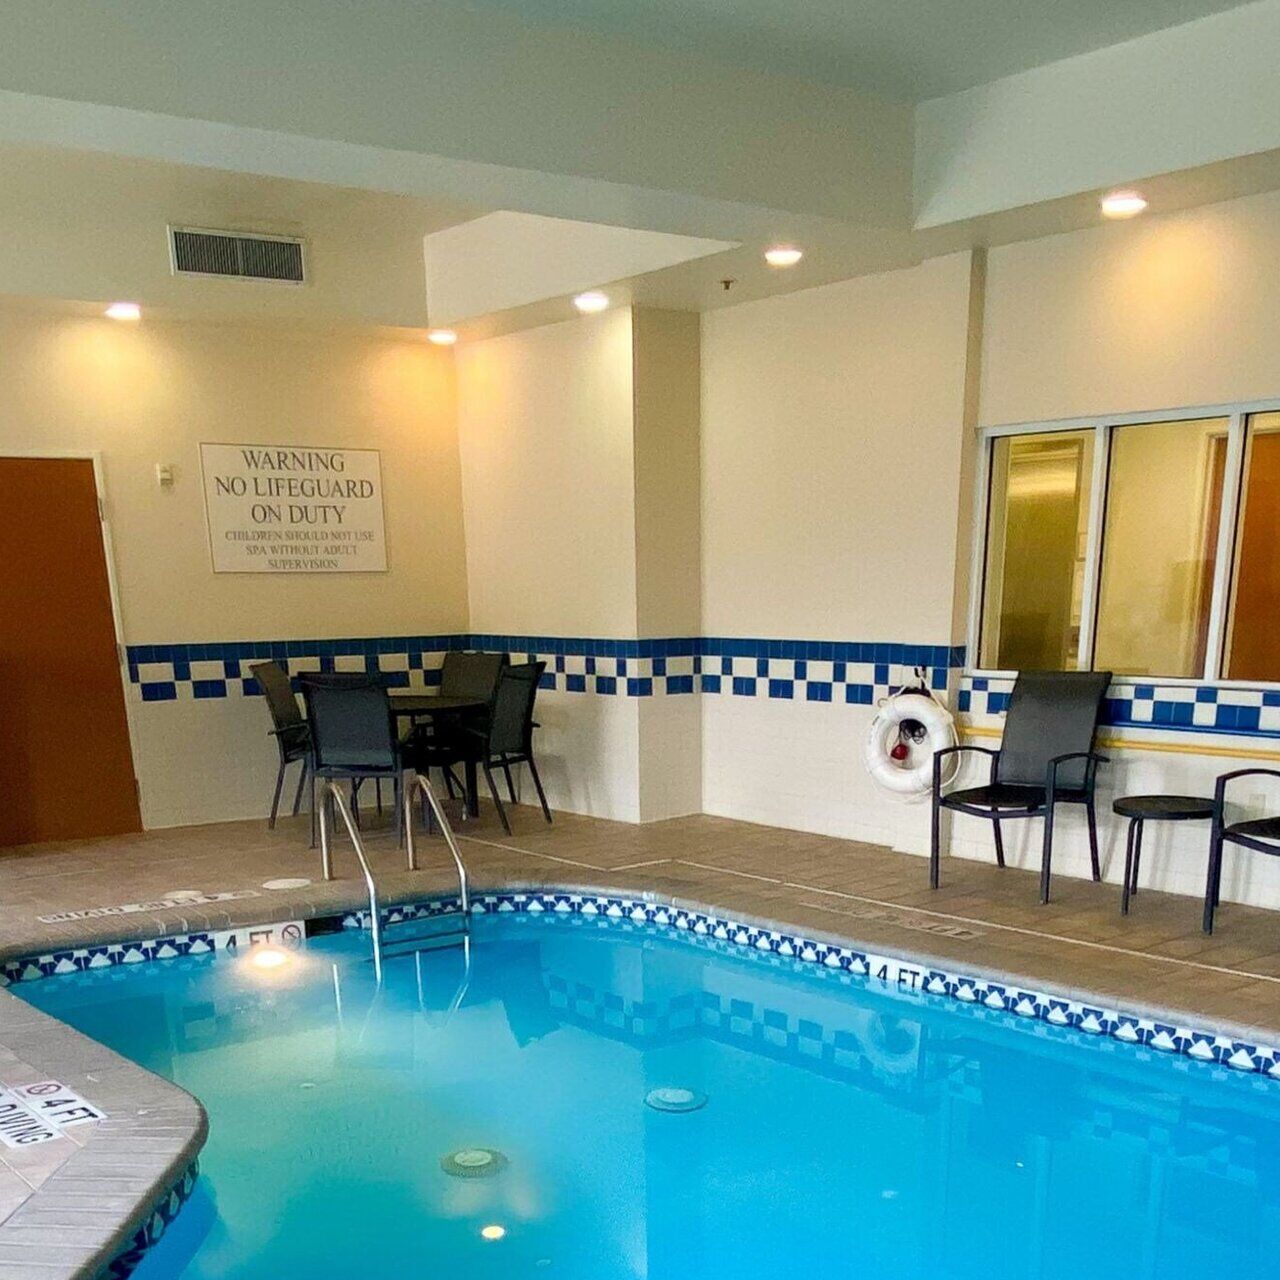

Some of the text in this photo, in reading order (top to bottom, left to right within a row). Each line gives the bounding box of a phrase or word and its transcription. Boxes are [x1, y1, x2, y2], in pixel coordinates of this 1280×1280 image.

[242, 449, 345, 473] WARNING
[214, 476, 374, 499] NO LIFEGUARD
[251, 503, 346, 524] ON DUTY
[225, 529, 375, 541] CHILDREN SHOULD NOT USE
[245, 544, 358, 556] SPA WITHOUT ADULT
[267, 558, 339, 570] SUPERVISION
[249, 929, 273, 945] FT
[897, 968, 920, 988] FT
[41, 1099, 98, 1124] 4 FT
